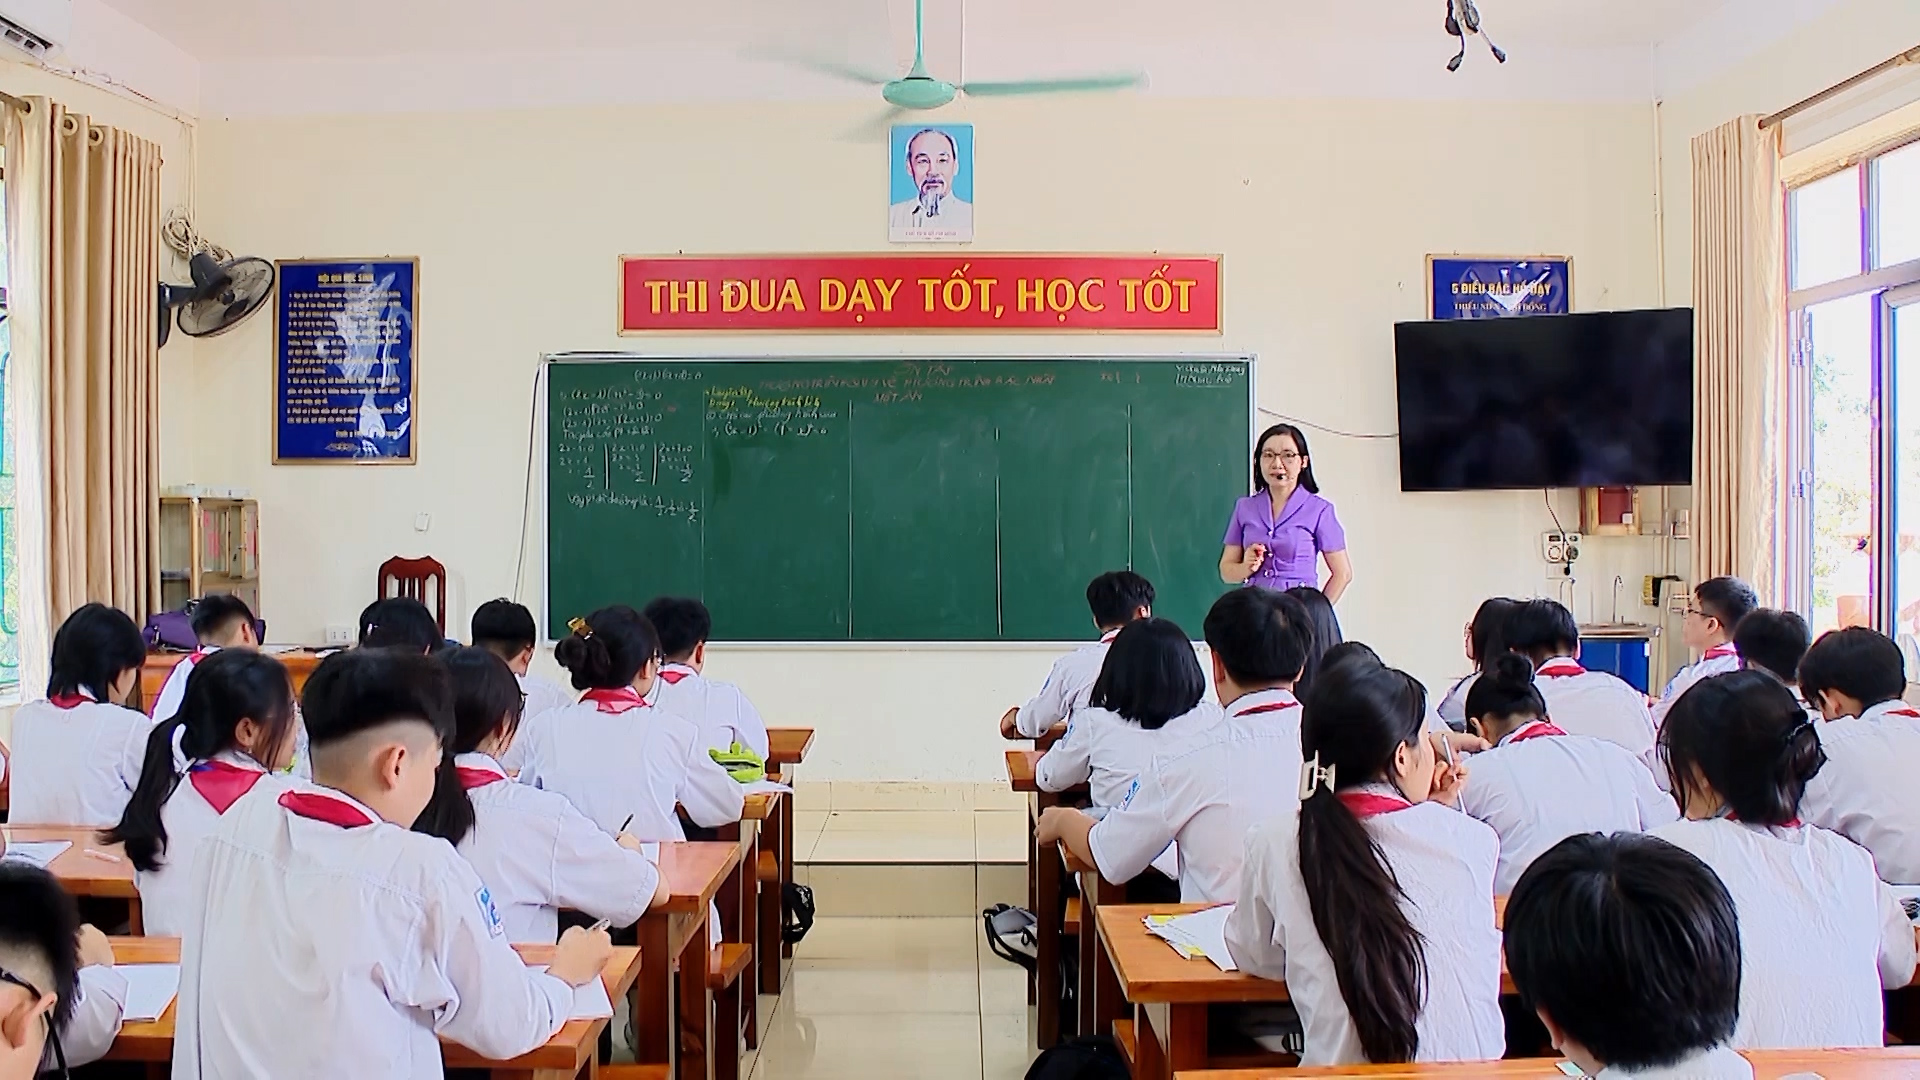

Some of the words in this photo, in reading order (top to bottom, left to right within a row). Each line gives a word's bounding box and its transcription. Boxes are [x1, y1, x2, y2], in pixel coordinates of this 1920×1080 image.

[644, 280, 707, 313] THI
[719, 280, 806, 312] ĐUA
[820, 279, 903, 322] DẠY
[917, 263, 1003, 318] TỐT,
[1018, 279, 1105, 322] HỌC
[1118, 264, 1197, 312] TỐT
